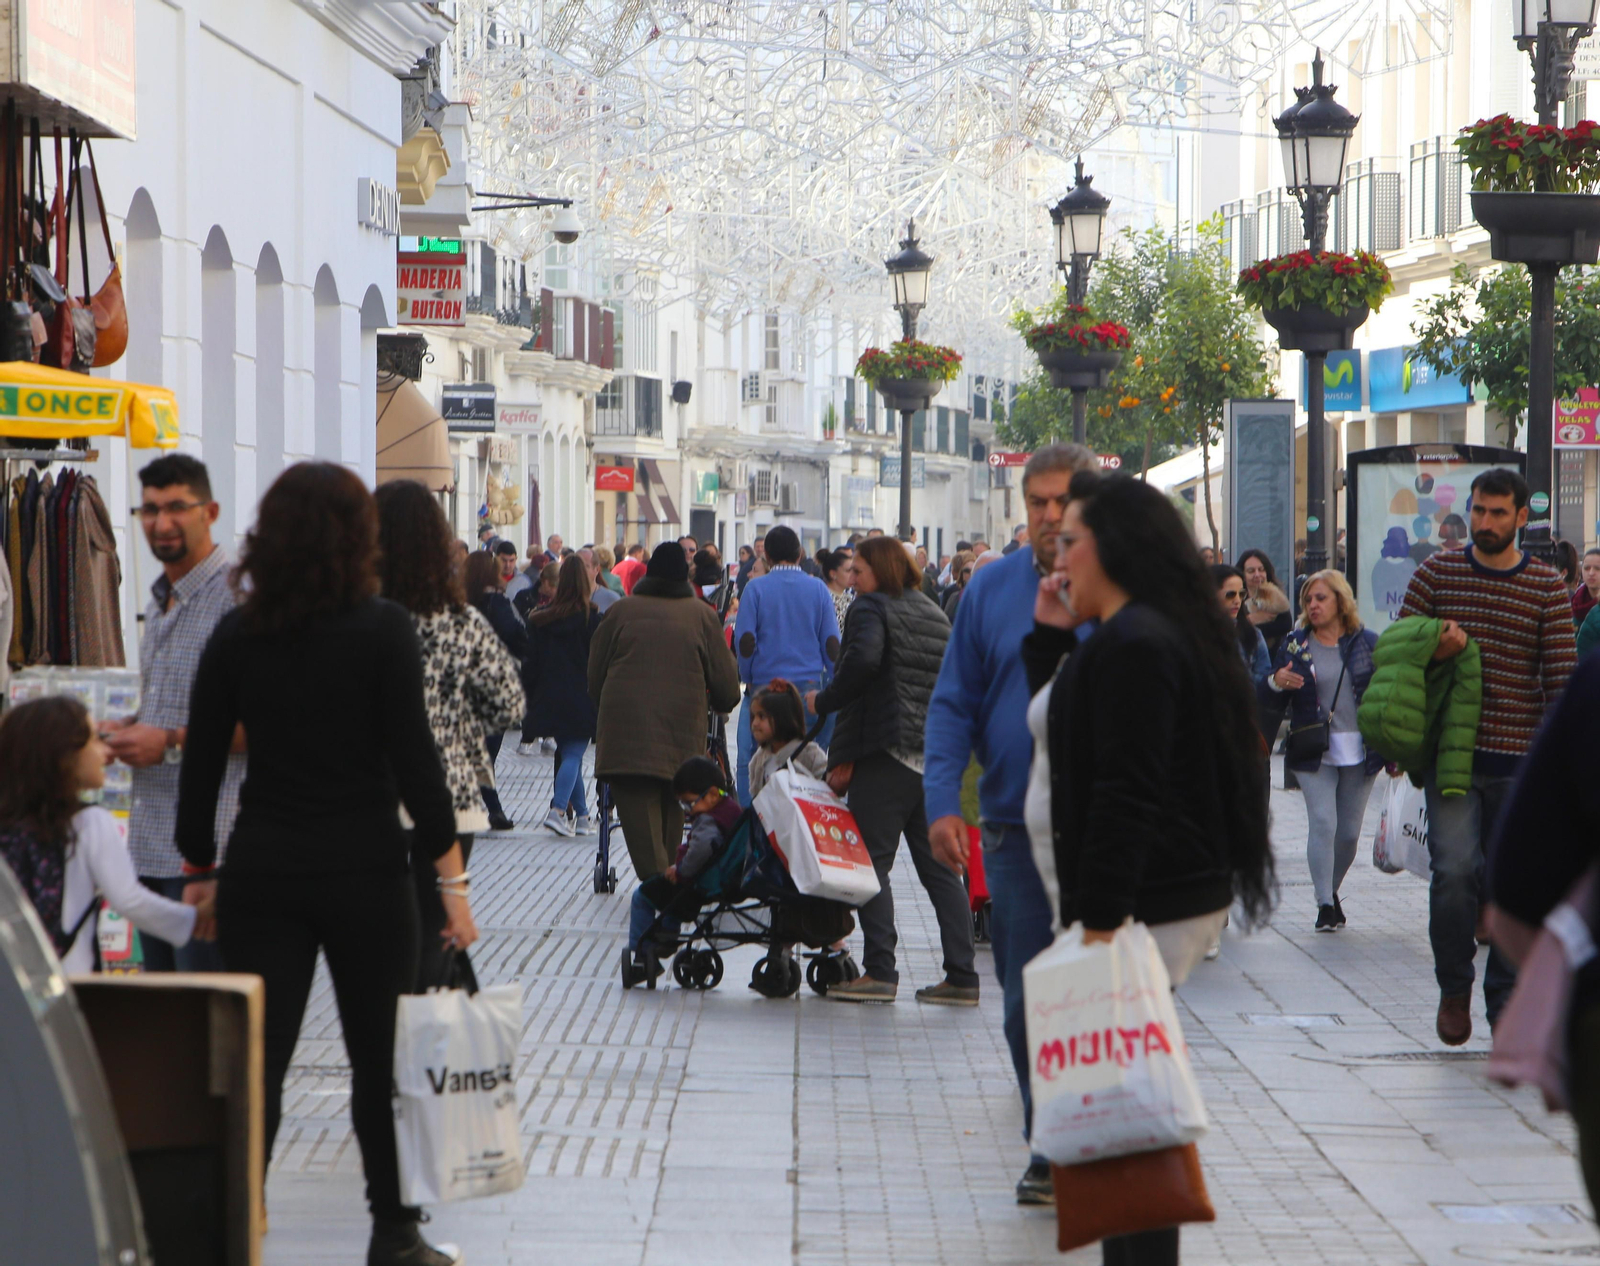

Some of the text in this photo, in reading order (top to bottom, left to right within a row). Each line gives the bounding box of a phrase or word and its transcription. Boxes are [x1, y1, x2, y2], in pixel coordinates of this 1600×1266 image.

[369, 177, 402, 236] DENTIX
[397, 268, 461, 289] NADERIA
[411, 300, 461, 319] BUTRON
[26, 392, 114, 415] ONCE
[1323, 391, 1353, 400] ovistar
[499, 409, 538, 426] katia
[1559, 415, 1591, 424] VELAS
